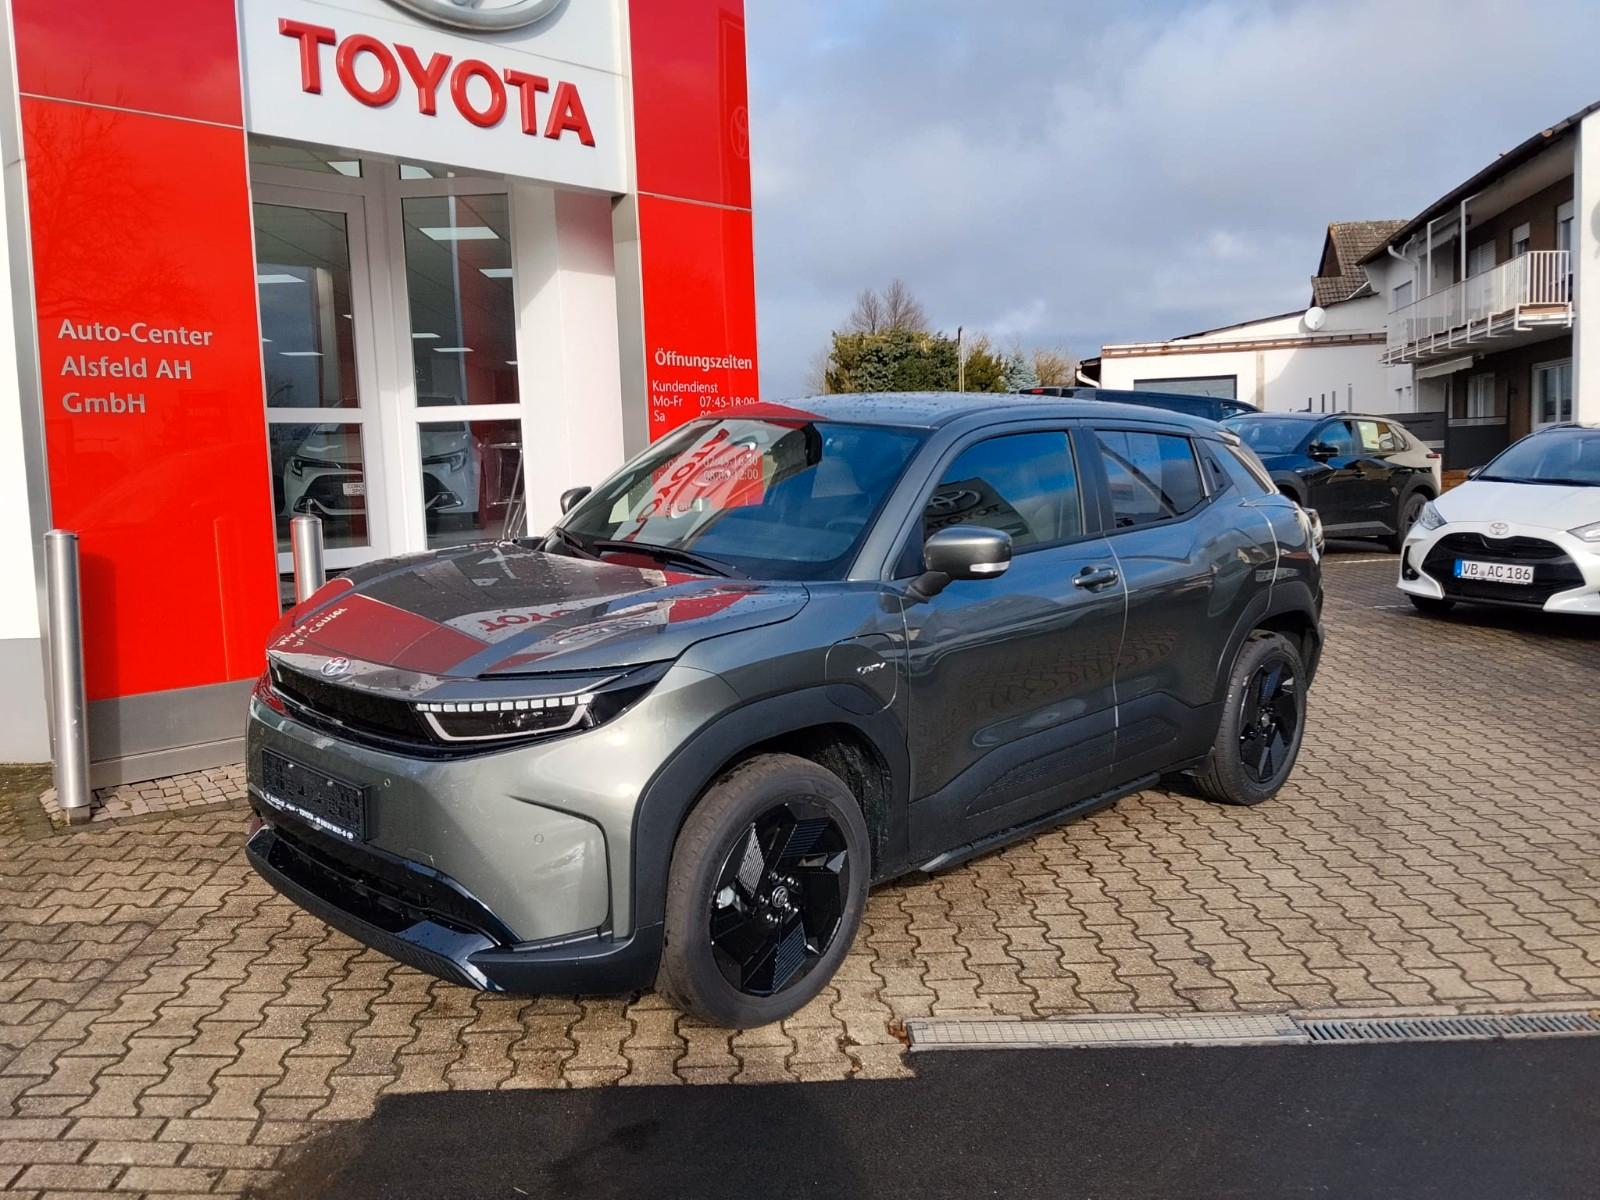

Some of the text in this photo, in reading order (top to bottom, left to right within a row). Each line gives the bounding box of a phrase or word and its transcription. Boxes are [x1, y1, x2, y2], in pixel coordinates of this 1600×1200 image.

[278, 18, 596, 147] TOYOTA
[58, 318, 213, 346] Auto-Center
[61, 355, 192, 380] Alsfeld AH
[655, 347, 753, 372] Öffnungszeiten
[652, 380, 718, 393] Kundendienst
[62, 392, 146, 413] GmbH
[653, 395, 683, 407] Mo-Fr
[654, 410, 665, 422] Sa
[1463, 563, 1531, 581] VB AC 186
